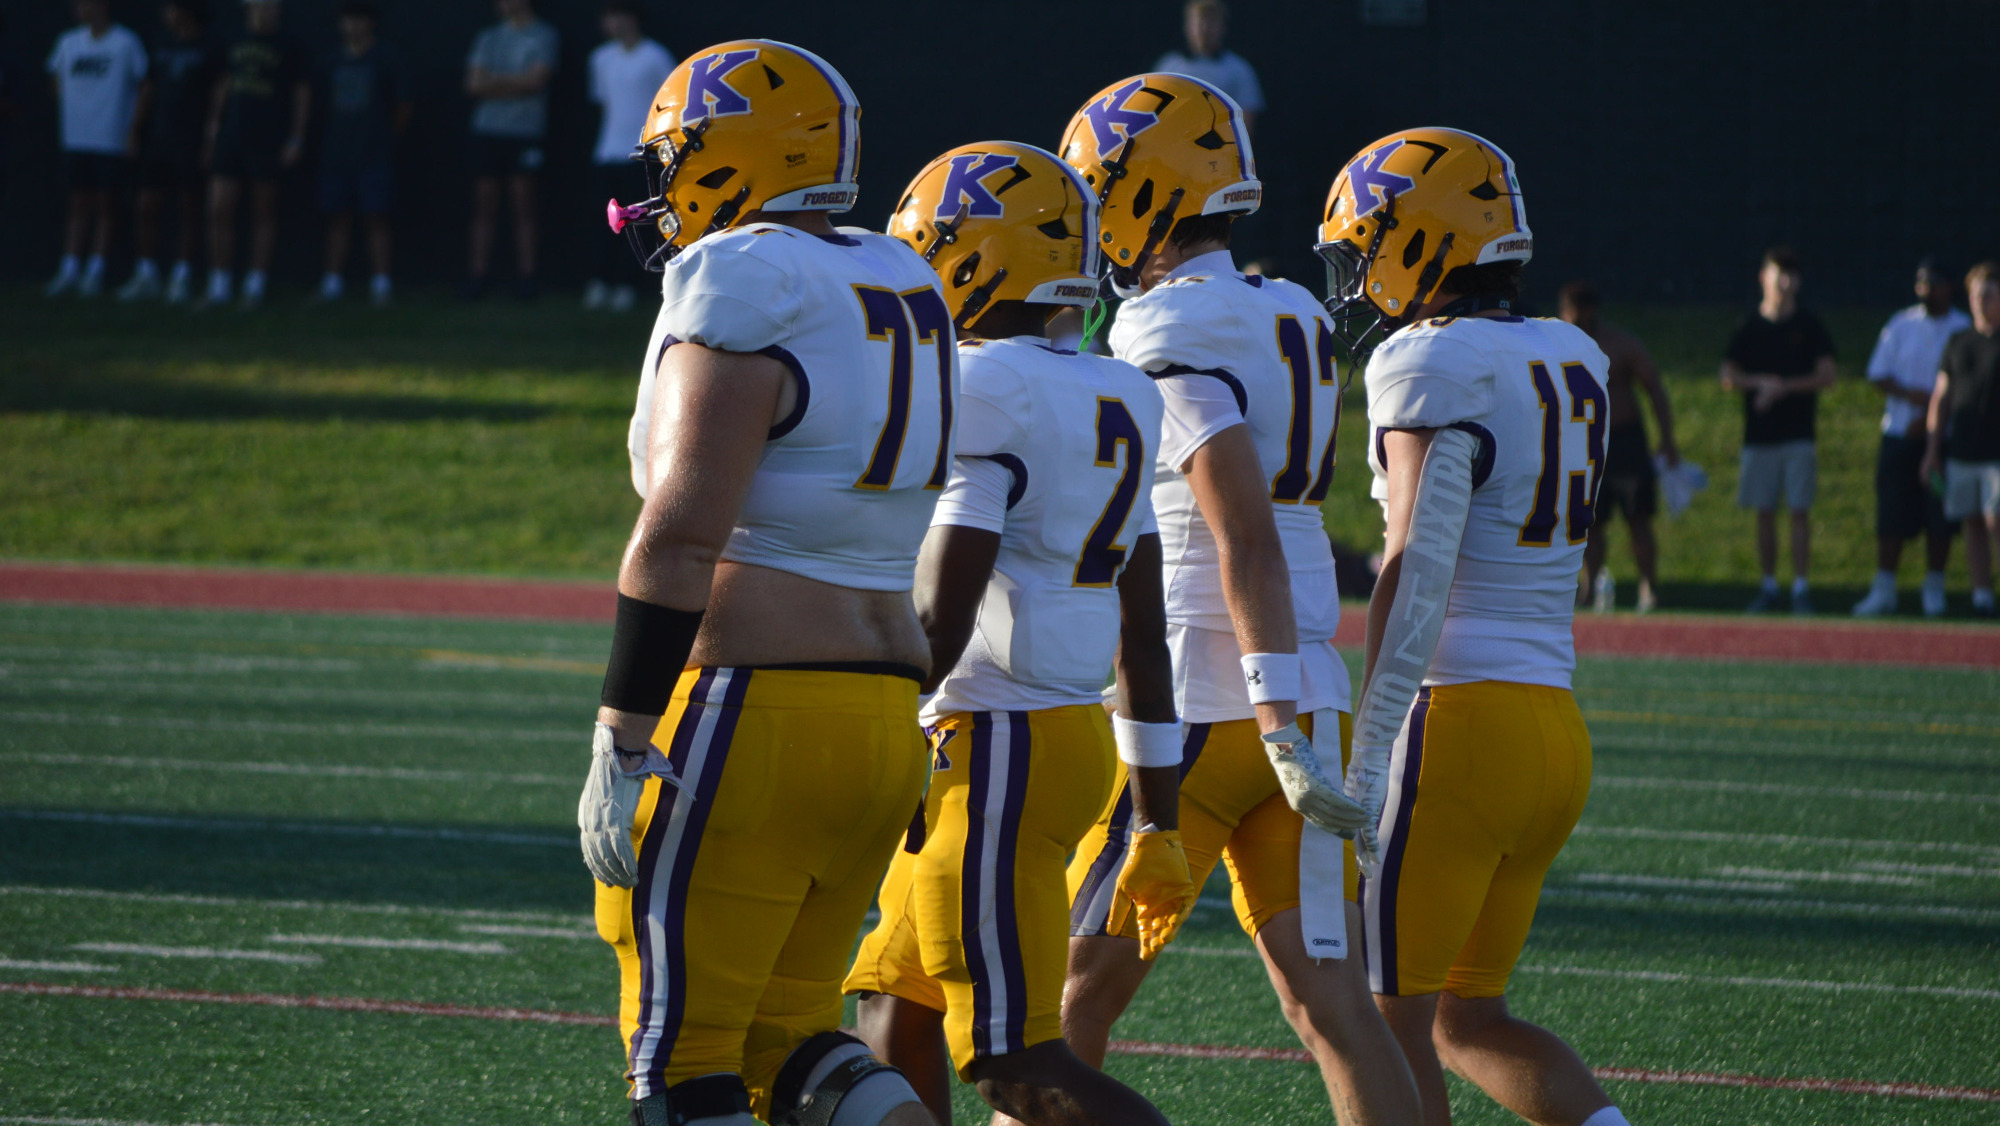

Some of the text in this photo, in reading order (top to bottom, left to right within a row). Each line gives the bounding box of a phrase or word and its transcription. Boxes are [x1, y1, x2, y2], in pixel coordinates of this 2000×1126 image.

[681, 48, 761, 126] K
[1083, 77, 1160, 159] K
[801, 191, 848, 206] FORGED
[934, 152, 1020, 220] K
[1223, 189, 1256, 205] FORGED
[1346, 138, 1416, 219] K
[1496, 239, 1529, 254] FORGED
[1054, 285, 1092, 298] FORGED
[849, 283, 955, 492] 77
[1071, 395, 1145, 588] 2
[1516, 360, 1608, 547] 13
